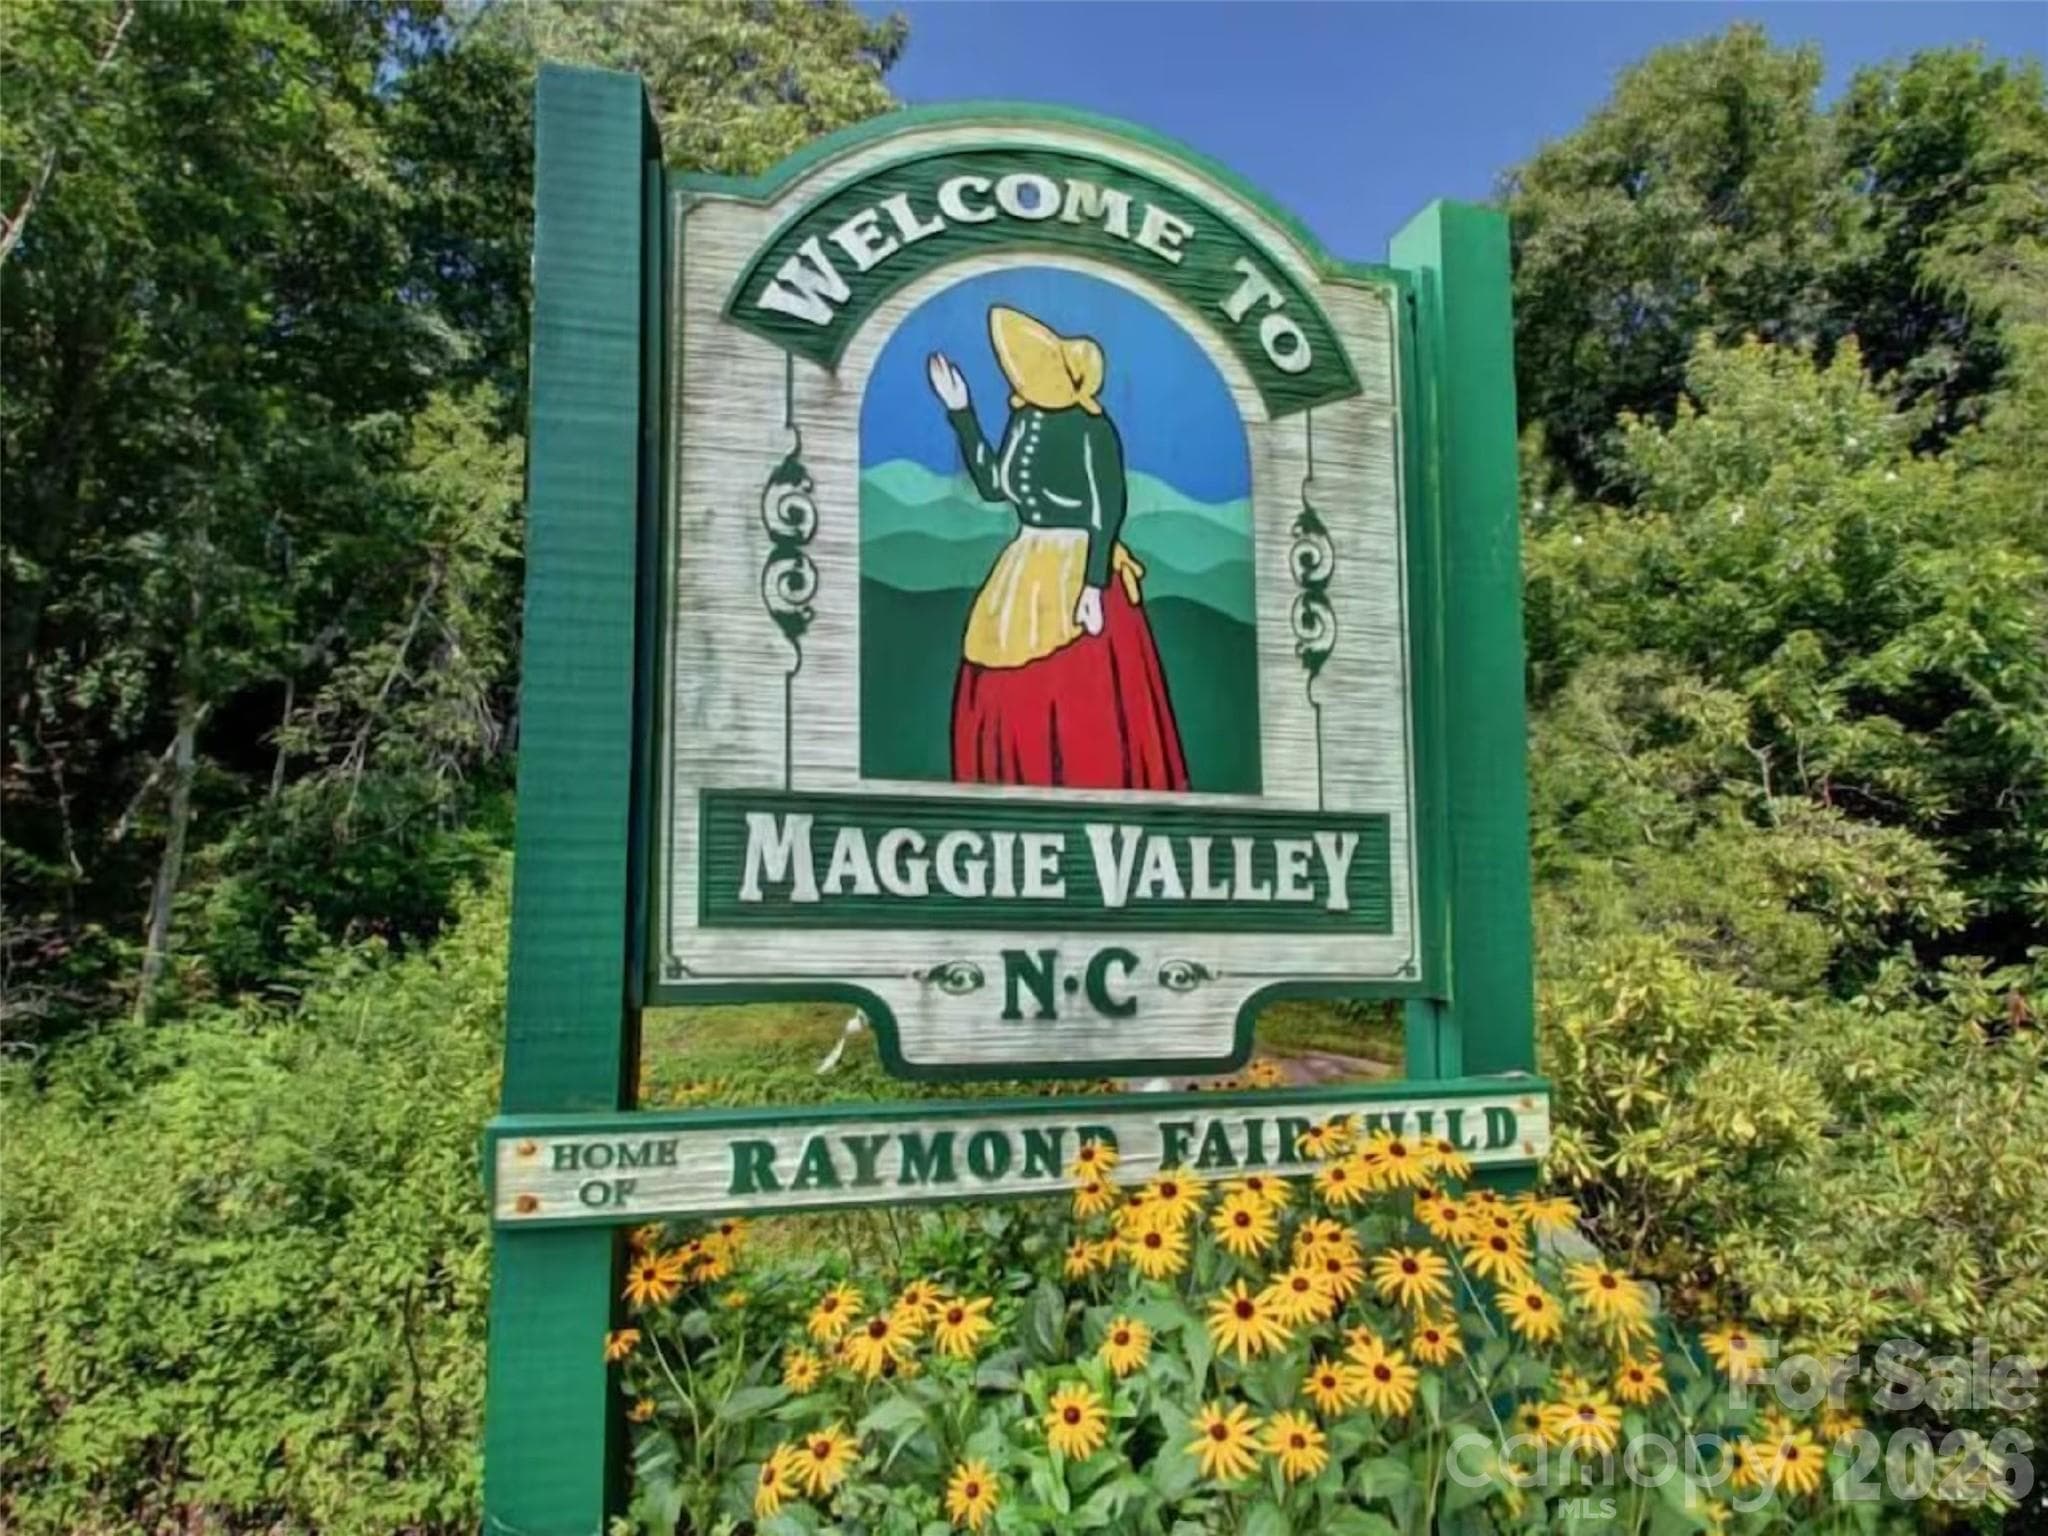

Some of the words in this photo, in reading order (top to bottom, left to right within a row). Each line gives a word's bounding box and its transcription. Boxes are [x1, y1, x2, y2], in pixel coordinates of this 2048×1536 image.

[757, 172, 1195, 328] WELCOME
[1218, 257, 1312, 374] TO
[739, 812, 1066, 902] MAGGIE
[1084, 824, 1359, 911] VALLEY
[551, 1138, 680, 1172] HOME
[1157, 1105, 1518, 1172] FAIRILD
[577, 1177, 637, 1209] OF
